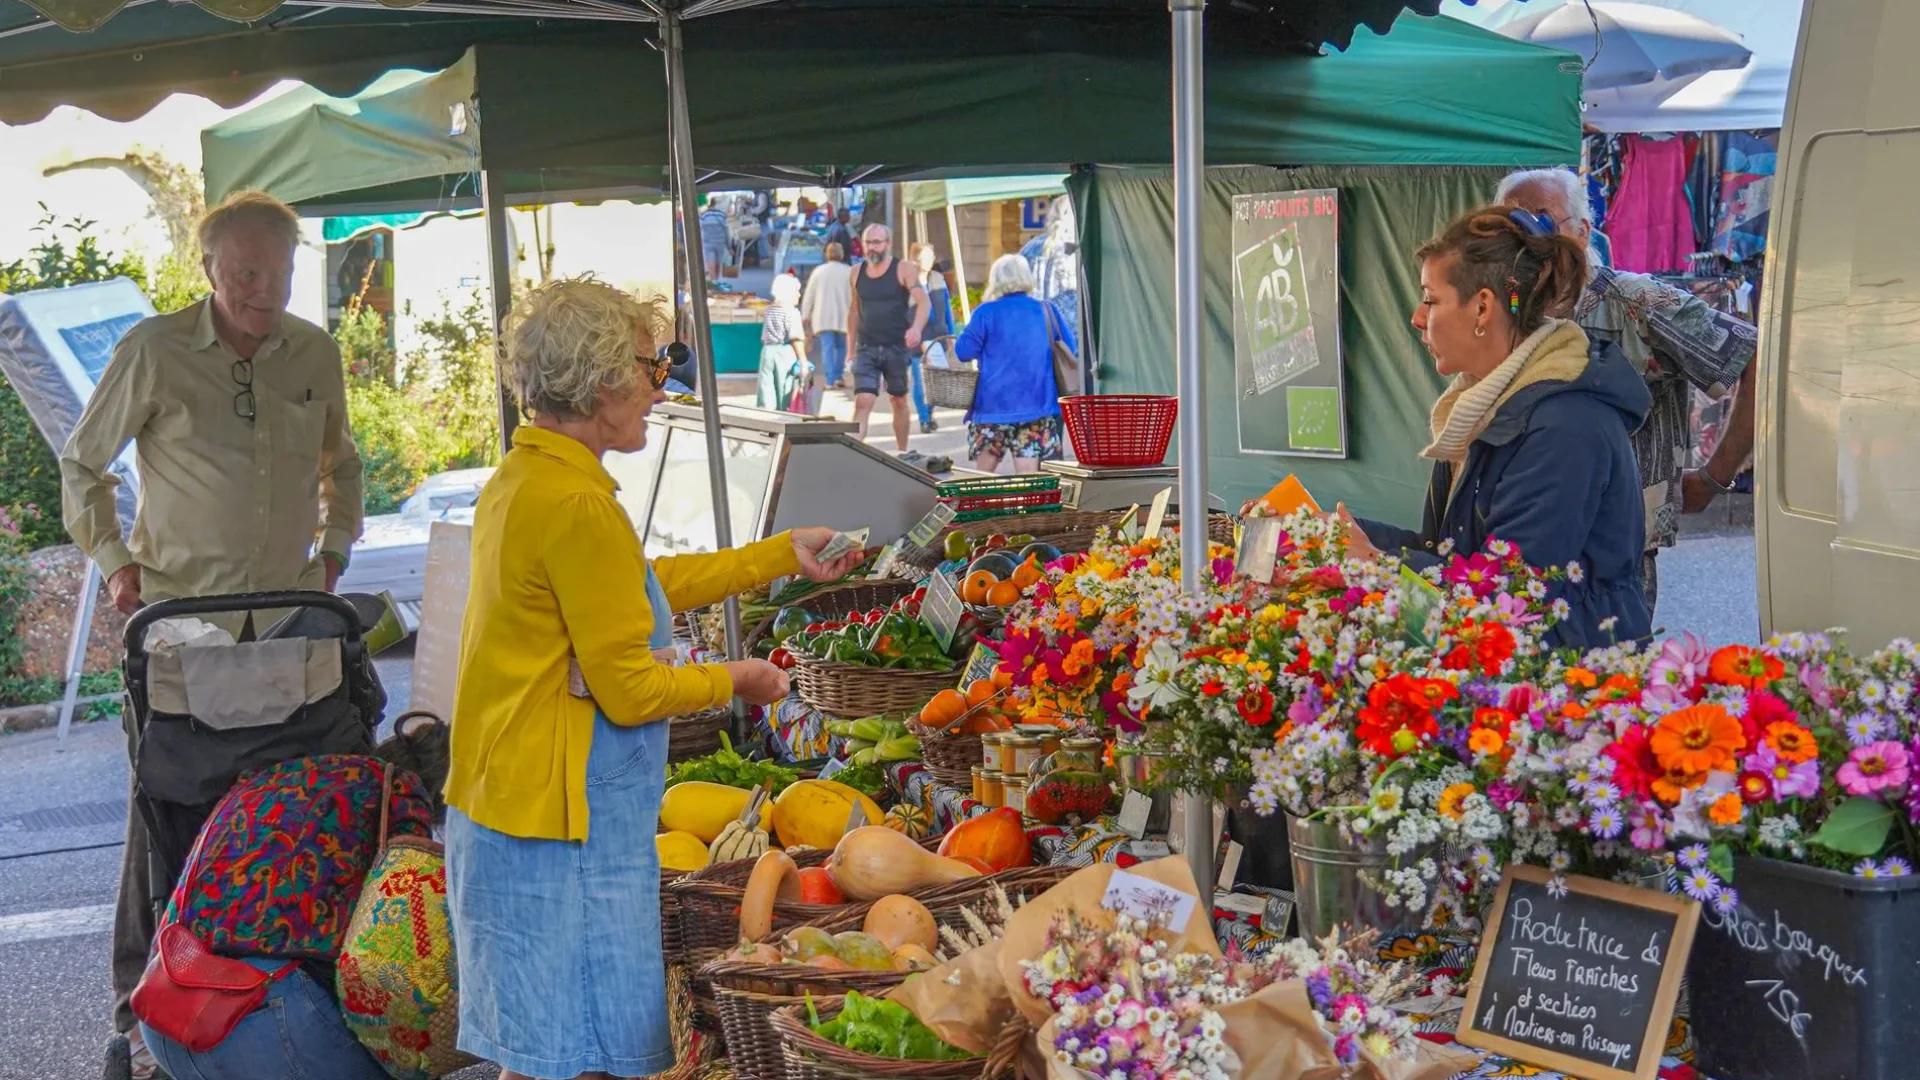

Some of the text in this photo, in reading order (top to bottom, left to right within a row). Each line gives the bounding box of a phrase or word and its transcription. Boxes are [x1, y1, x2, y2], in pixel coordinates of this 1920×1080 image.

[1254, 197, 1309, 220] PRODUITS
[1255, 268, 1298, 348] AB
[1518, 987, 1532, 1008] et
